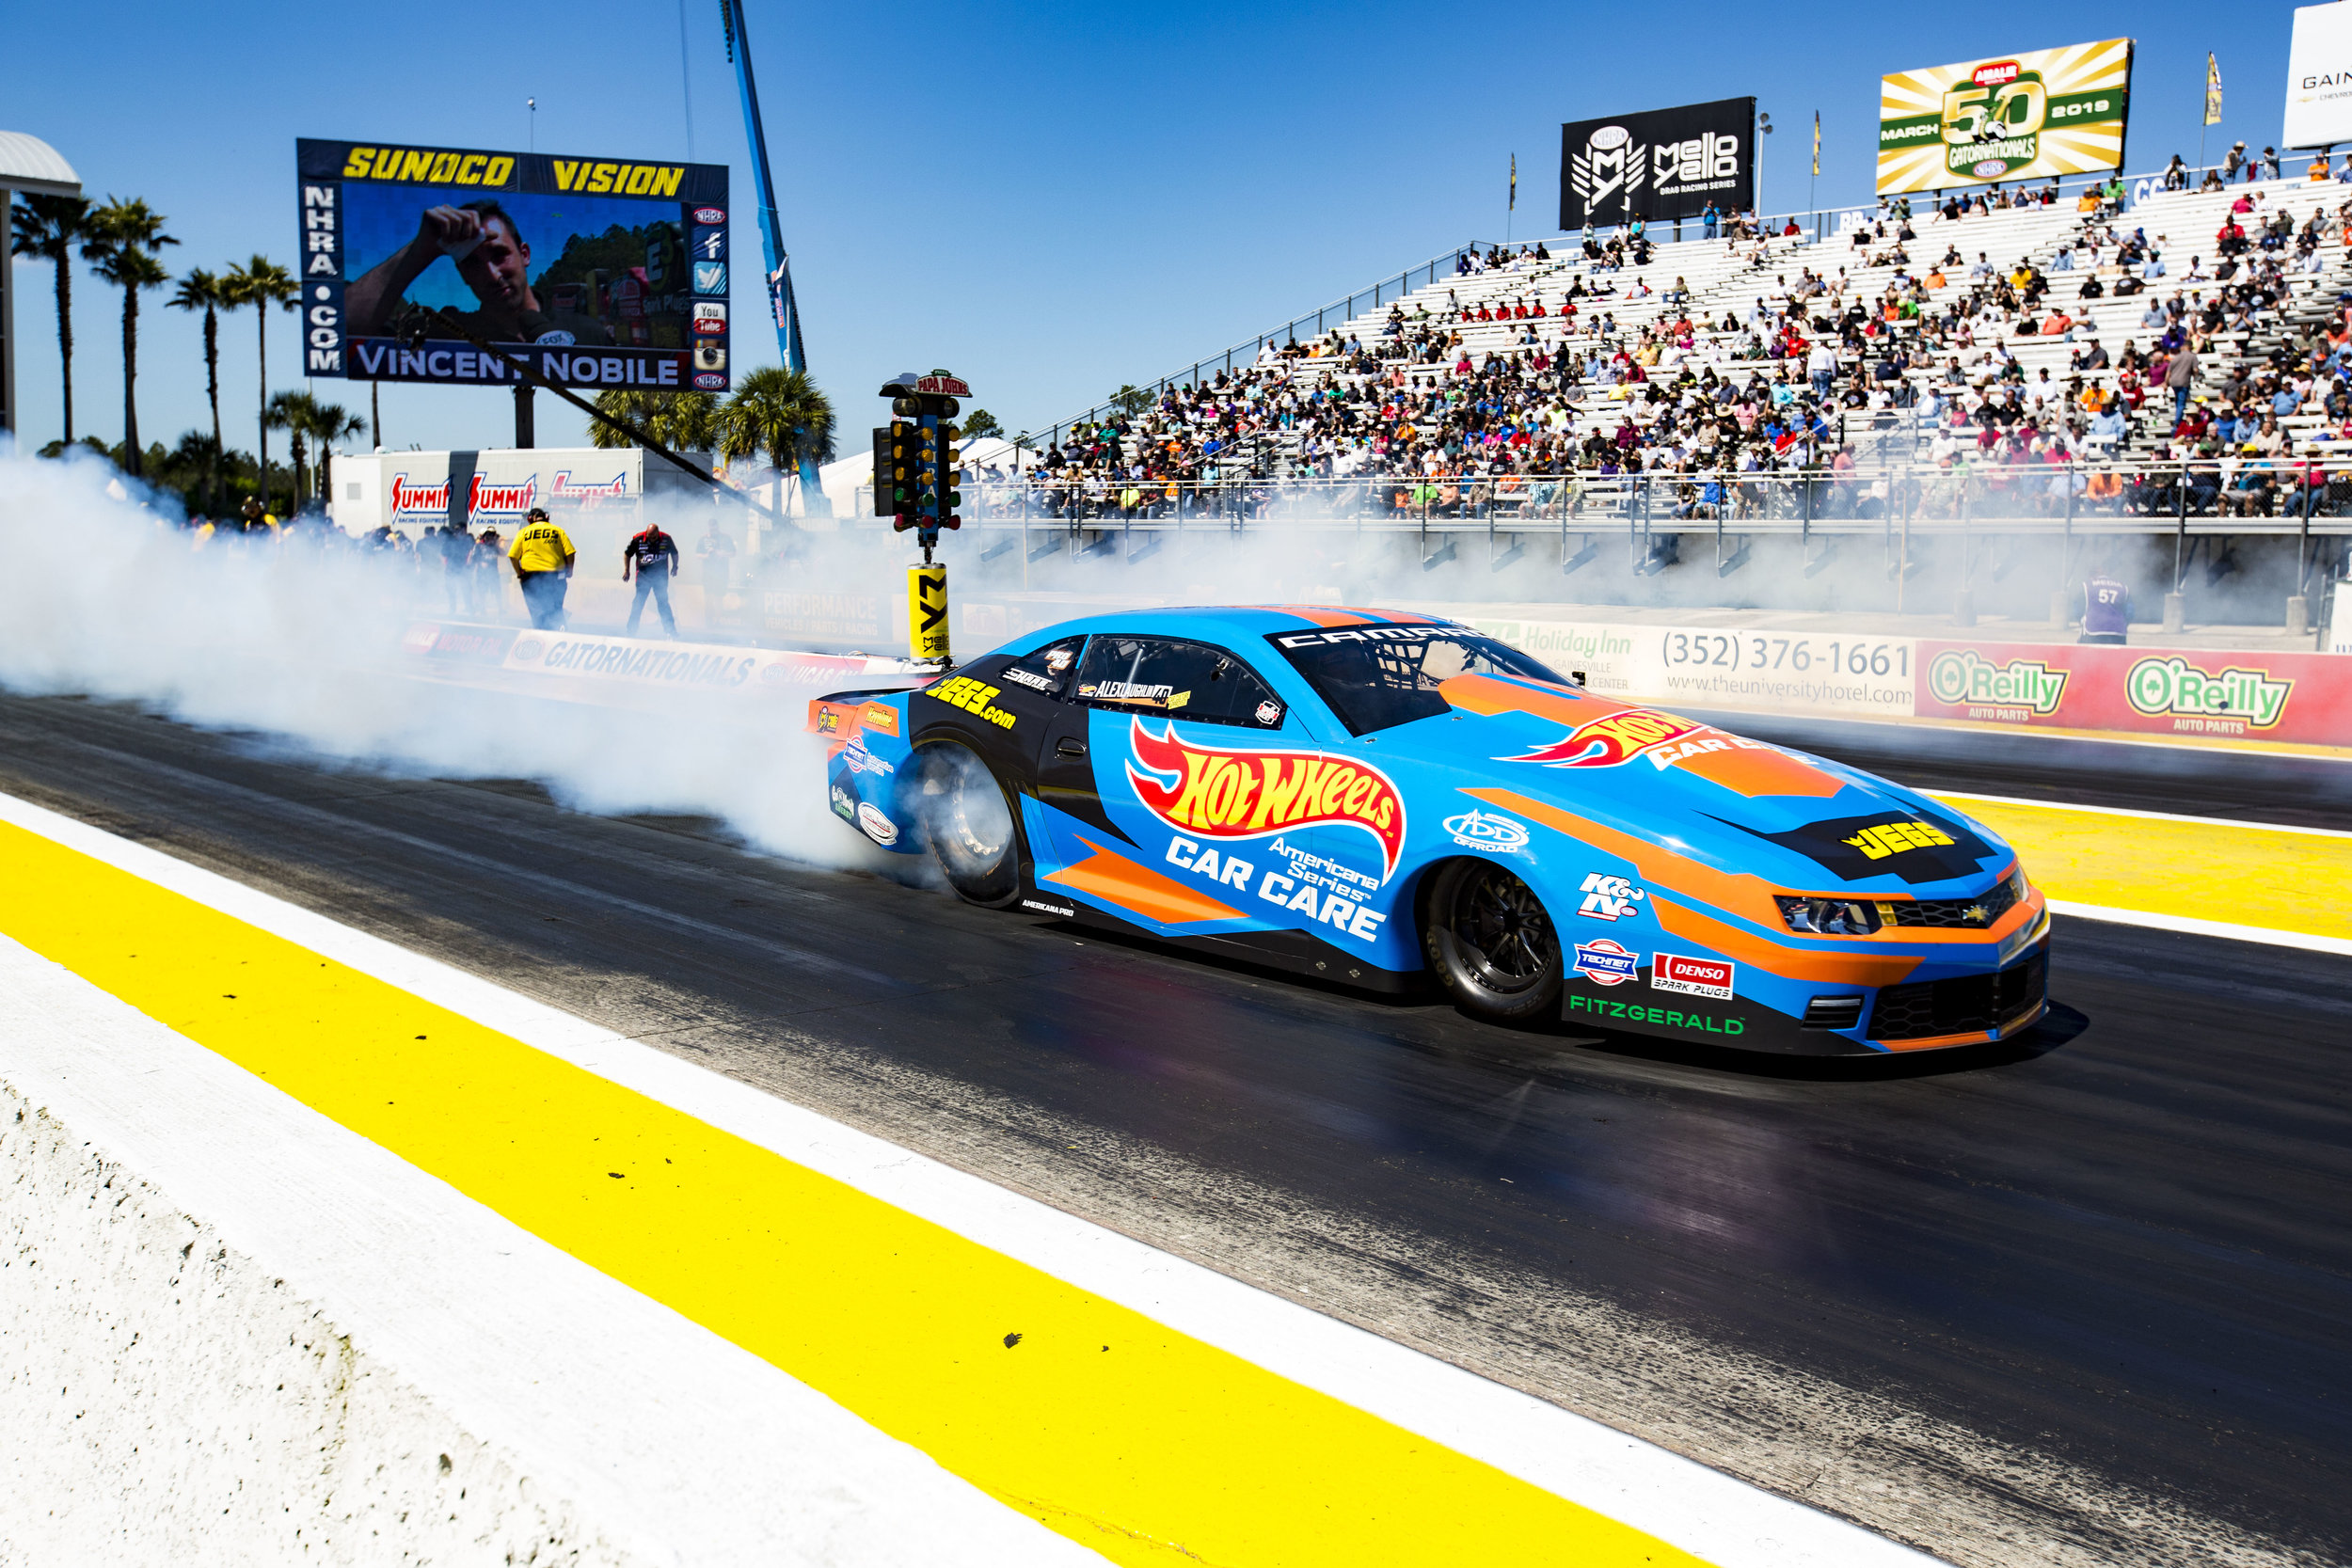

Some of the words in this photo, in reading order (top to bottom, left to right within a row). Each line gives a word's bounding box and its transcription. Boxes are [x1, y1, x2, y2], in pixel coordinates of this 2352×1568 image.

[1975, 64, 2018, 82] AMALIE
[1943, 81, 2045, 144] 50
[2051, 99, 2110, 119] 2019
[1881, 123, 1939, 141] MARCH
[1949, 137, 2037, 168] GATORNATIONALS
[342, 147, 516, 186] SUNOCO
[553, 160, 685, 197] VISION
[1660, 184, 1679, 196] DRAG
[1681, 182, 1708, 194] RACING
[1709, 179, 1737, 190] SERIES
[696, 210, 723, 222] NHRA
[701, 305, 719, 318] You
[698, 319, 722, 332] Tube
[542, 352, 679, 386] NOBILE
[696, 375, 725, 388] NHRA
[918, 376, 940, 393] PAPA
[941, 376, 968, 395] JOHNS
[390, 473, 453, 517] SUMMIT
[469, 472, 537, 517] SUMMIT
[524, 528, 560, 542] JEGS
[763, 591, 879, 621] PERFORMANCE
[2098, 588, 2119, 604] 57
[764, 616, 803, 632] VEHICLES
[811, 620, 836, 635] PARTS
[845, 621, 879, 637] RACING
[437, 632, 481, 653] MOTOR
[1525, 626, 1599, 658] Holiday
[1599, 630, 1632, 656] Inn
[544, 641, 755, 687] GATORNATIONALS
[1044, 649, 1073, 661] PRO
[1047, 658, 1072, 670] 40
[1662, 631, 1740, 672] (352)
[1750, 637, 1909, 677] 376-1661
[787, 663, 834, 686] LUCAS
[1553, 658, 1612, 673] GAINESVILLE
[1667, 673, 1913, 705] www.theuniversityhotel.com
[1934, 656, 2058, 707] O'Reilly
[2135, 664, 2280, 720] O'Reilly
[1968, 706, 1994, 720] AUTO
[1995, 708, 2029, 721] PARTS
[2173, 719, 2204, 732] AUTO
[2206, 721, 2245, 735] PARTS
[1647, 738, 1734, 771] CAR
[1453, 835, 1518, 853] OFFROAD
[1856, 821, 1956, 861] JEGS
[1268, 836, 1380, 892] Americana
[1165, 835, 1255, 892] CAR
[1258, 871, 1388, 943] CARE
[1286, 861, 1365, 903] Series
[1022, 899, 1060, 915] AMERICANA
[1058, 908, 1074, 918] PRO
[1674, 962, 1725, 981] DENSO
[1653, 978, 1689, 992] SPARK
[1692, 984, 1730, 998] PLUGS
[1569, 994, 1745, 1036] FITZGERALD
